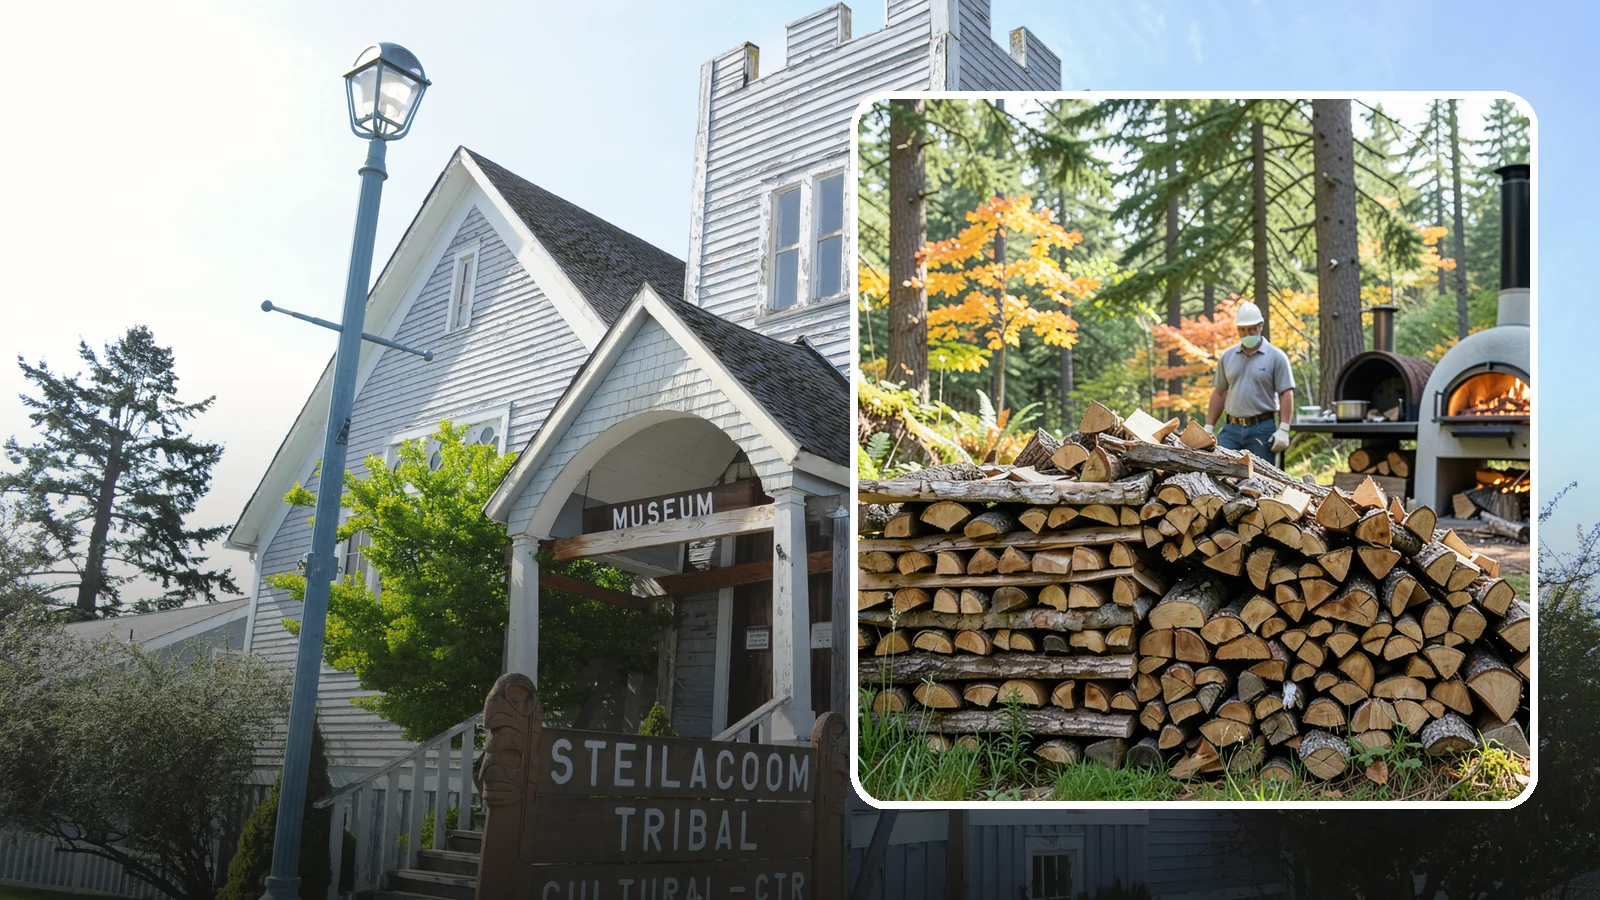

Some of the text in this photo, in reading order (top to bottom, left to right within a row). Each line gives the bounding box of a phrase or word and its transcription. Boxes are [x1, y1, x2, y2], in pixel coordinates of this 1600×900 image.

[612, 491, 713, 531] MUSEUM
[550, 738, 810, 792] STEILACOOM
[615, 806, 758, 852] TRIBAL
